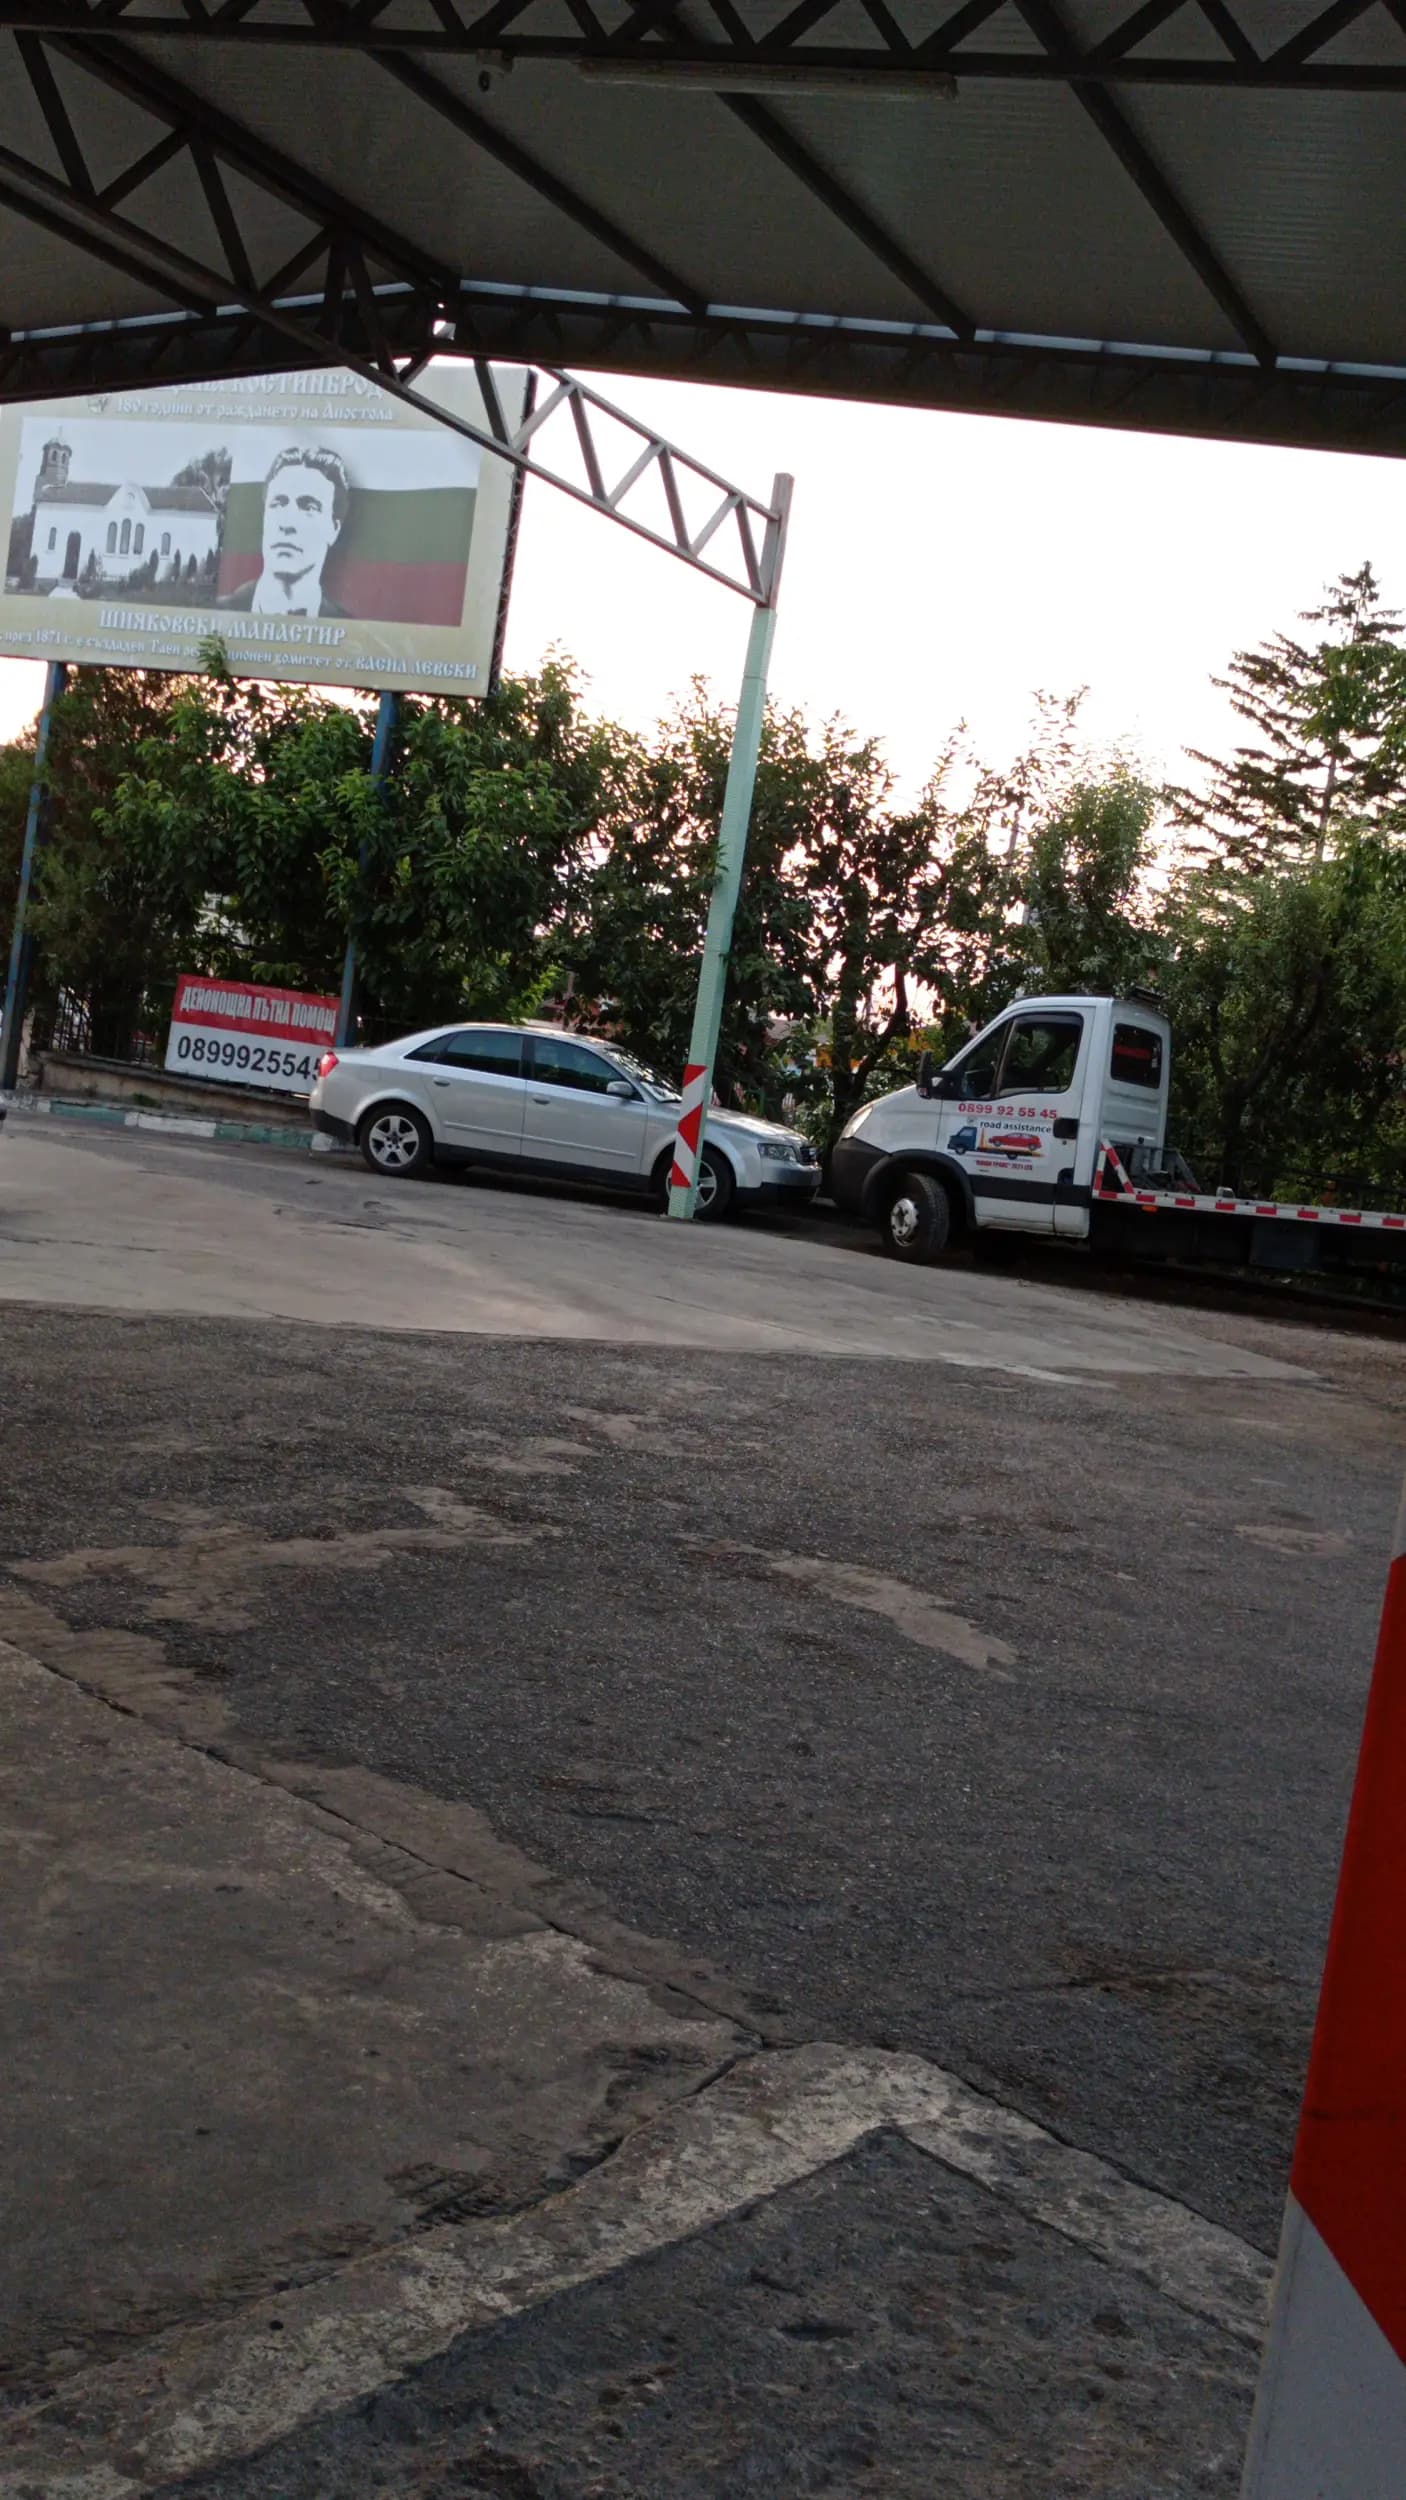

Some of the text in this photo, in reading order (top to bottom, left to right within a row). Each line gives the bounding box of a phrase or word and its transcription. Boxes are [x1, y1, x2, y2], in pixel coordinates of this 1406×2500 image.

[144, 402, 193, 418] години
[197, 404, 214, 416] от
[216, 403, 299, 421] раждането
[301, 406, 319, 419] на
[322, 400, 394, 421] Апостола
[227, 620, 346, 647] МАНАСТИР
[355, 655, 408, 674] ВАСИЛ
[411, 661, 478, 681] ЛЕВСКИ
[180, 985, 337, 1036] ДЕНОНОЩНА ПЪТНА ПОМОЩ
[958, 1103, 1058, 1119] 0899 92 55 45
[980, 1120, 1052, 1134] road assistance
